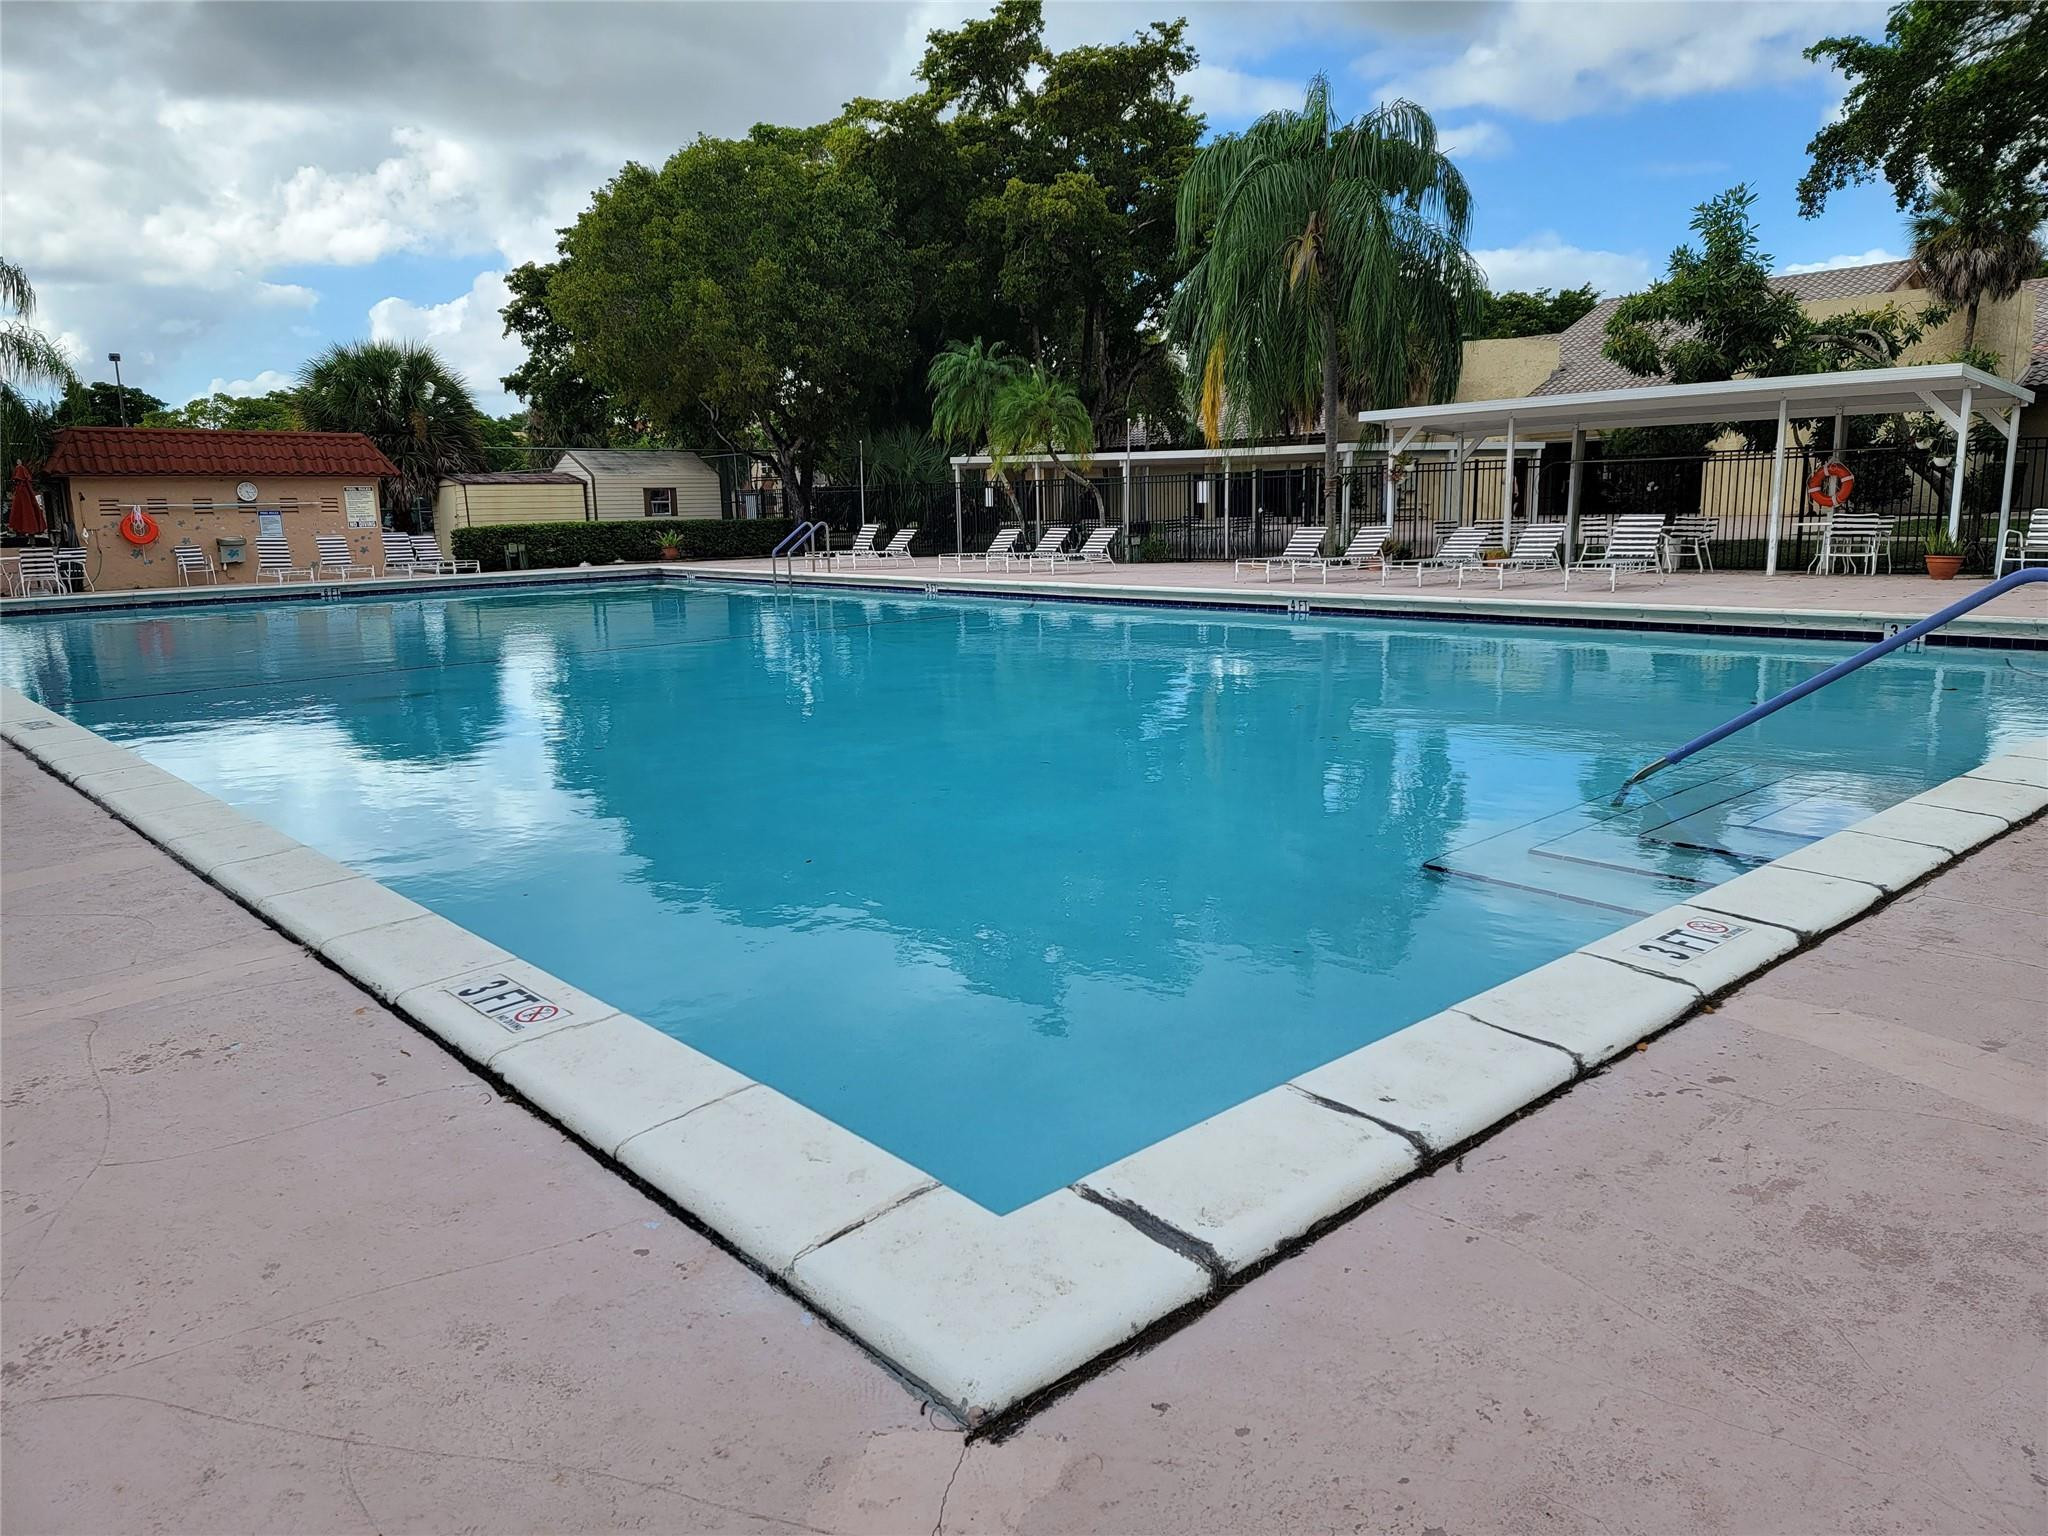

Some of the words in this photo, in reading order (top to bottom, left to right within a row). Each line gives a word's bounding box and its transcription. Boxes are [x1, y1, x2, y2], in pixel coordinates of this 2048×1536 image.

[1298, 600, 1308, 611] FT
[1656, 928, 1720, 952] FT
[1638, 944, 1690, 960] 3
[457, 980, 509, 997] 3
[472, 988, 541, 1013] FT
